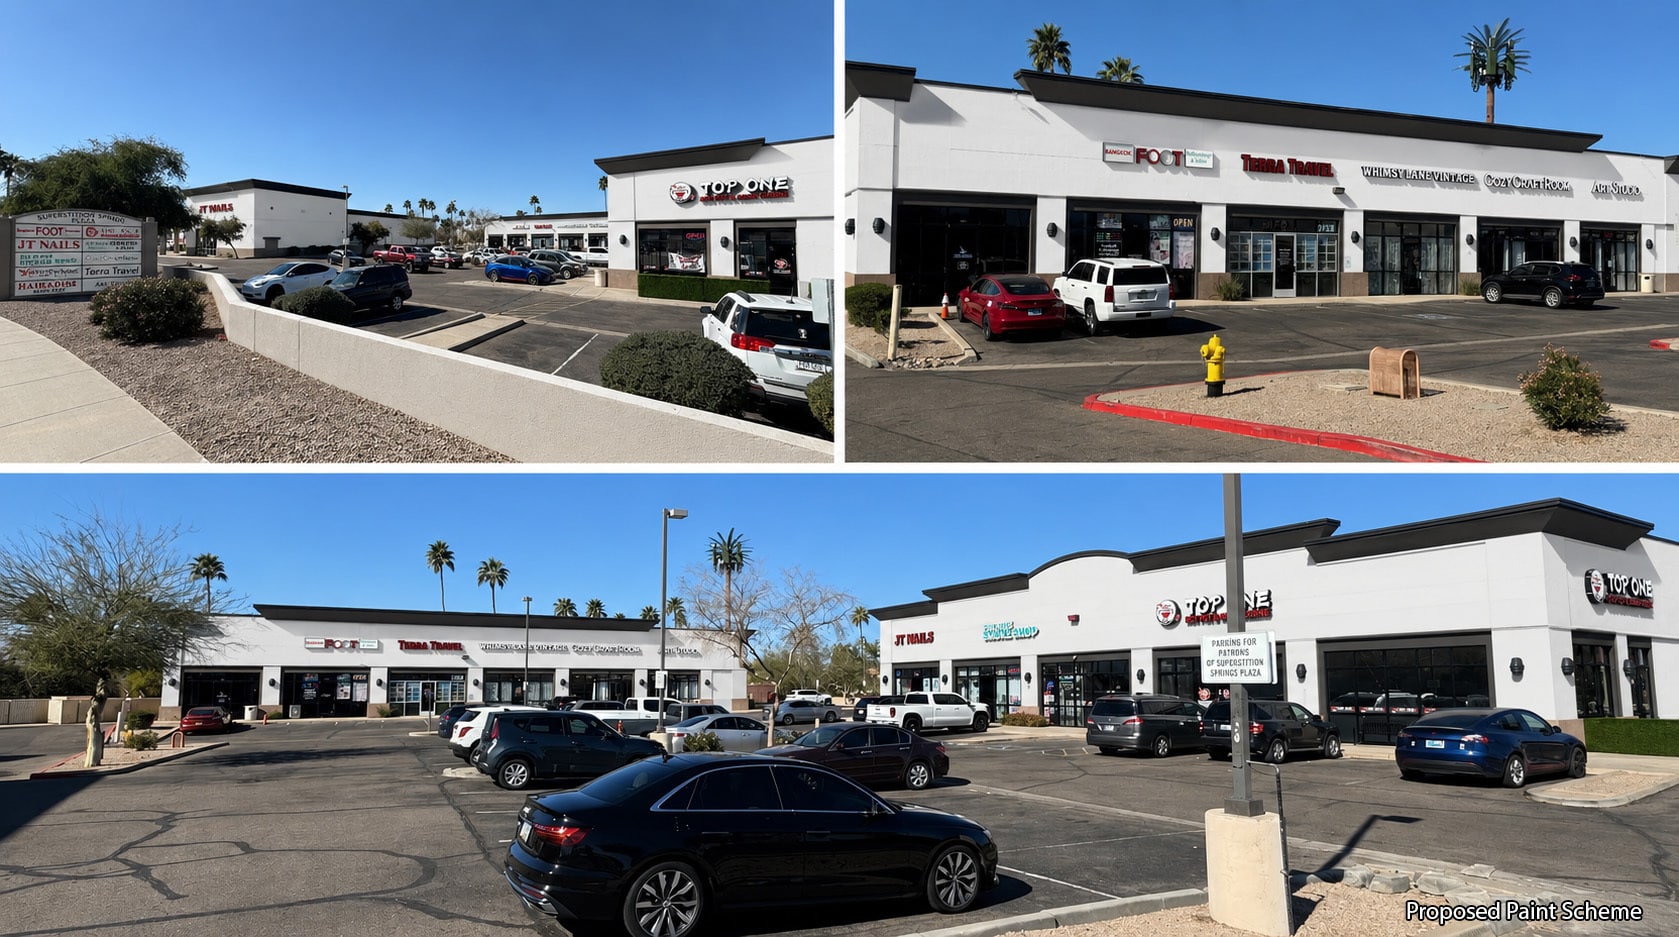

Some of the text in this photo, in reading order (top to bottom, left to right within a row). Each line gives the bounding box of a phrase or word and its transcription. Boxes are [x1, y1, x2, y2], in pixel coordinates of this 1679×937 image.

[1136, 147, 1184, 167] FOOT
[1241, 154, 1335, 178] TERRA TRAVEL
[1360, 166, 1476, 184] WHIMSY LANE VINTAGE
[699, 177, 789, 194] TOP ONE
[209, 203, 234, 213] NAILS
[1173, 218, 1194, 228] OPEN
[36, 226, 65, 236] FOOT
[18, 240, 37, 249] JT
[40, 240, 81, 249] NAILS
[112, 266, 140, 275] Travel
[1607, 573, 1653, 598] TOP ONE
[1185, 594, 1223, 615] TOP
[1243, 589, 1271, 611] NE
[324, 638, 360, 649] FOOT
[895, 631, 935, 646] JT NAILS
[1211, 637, 1257, 647] PARKING FOR
[1218, 648, 1250, 657] PATRONS
[1206, 658, 1264, 667] OF SUPERSTITION
[1210, 668, 1262, 677] SPRINGS PLAZA
